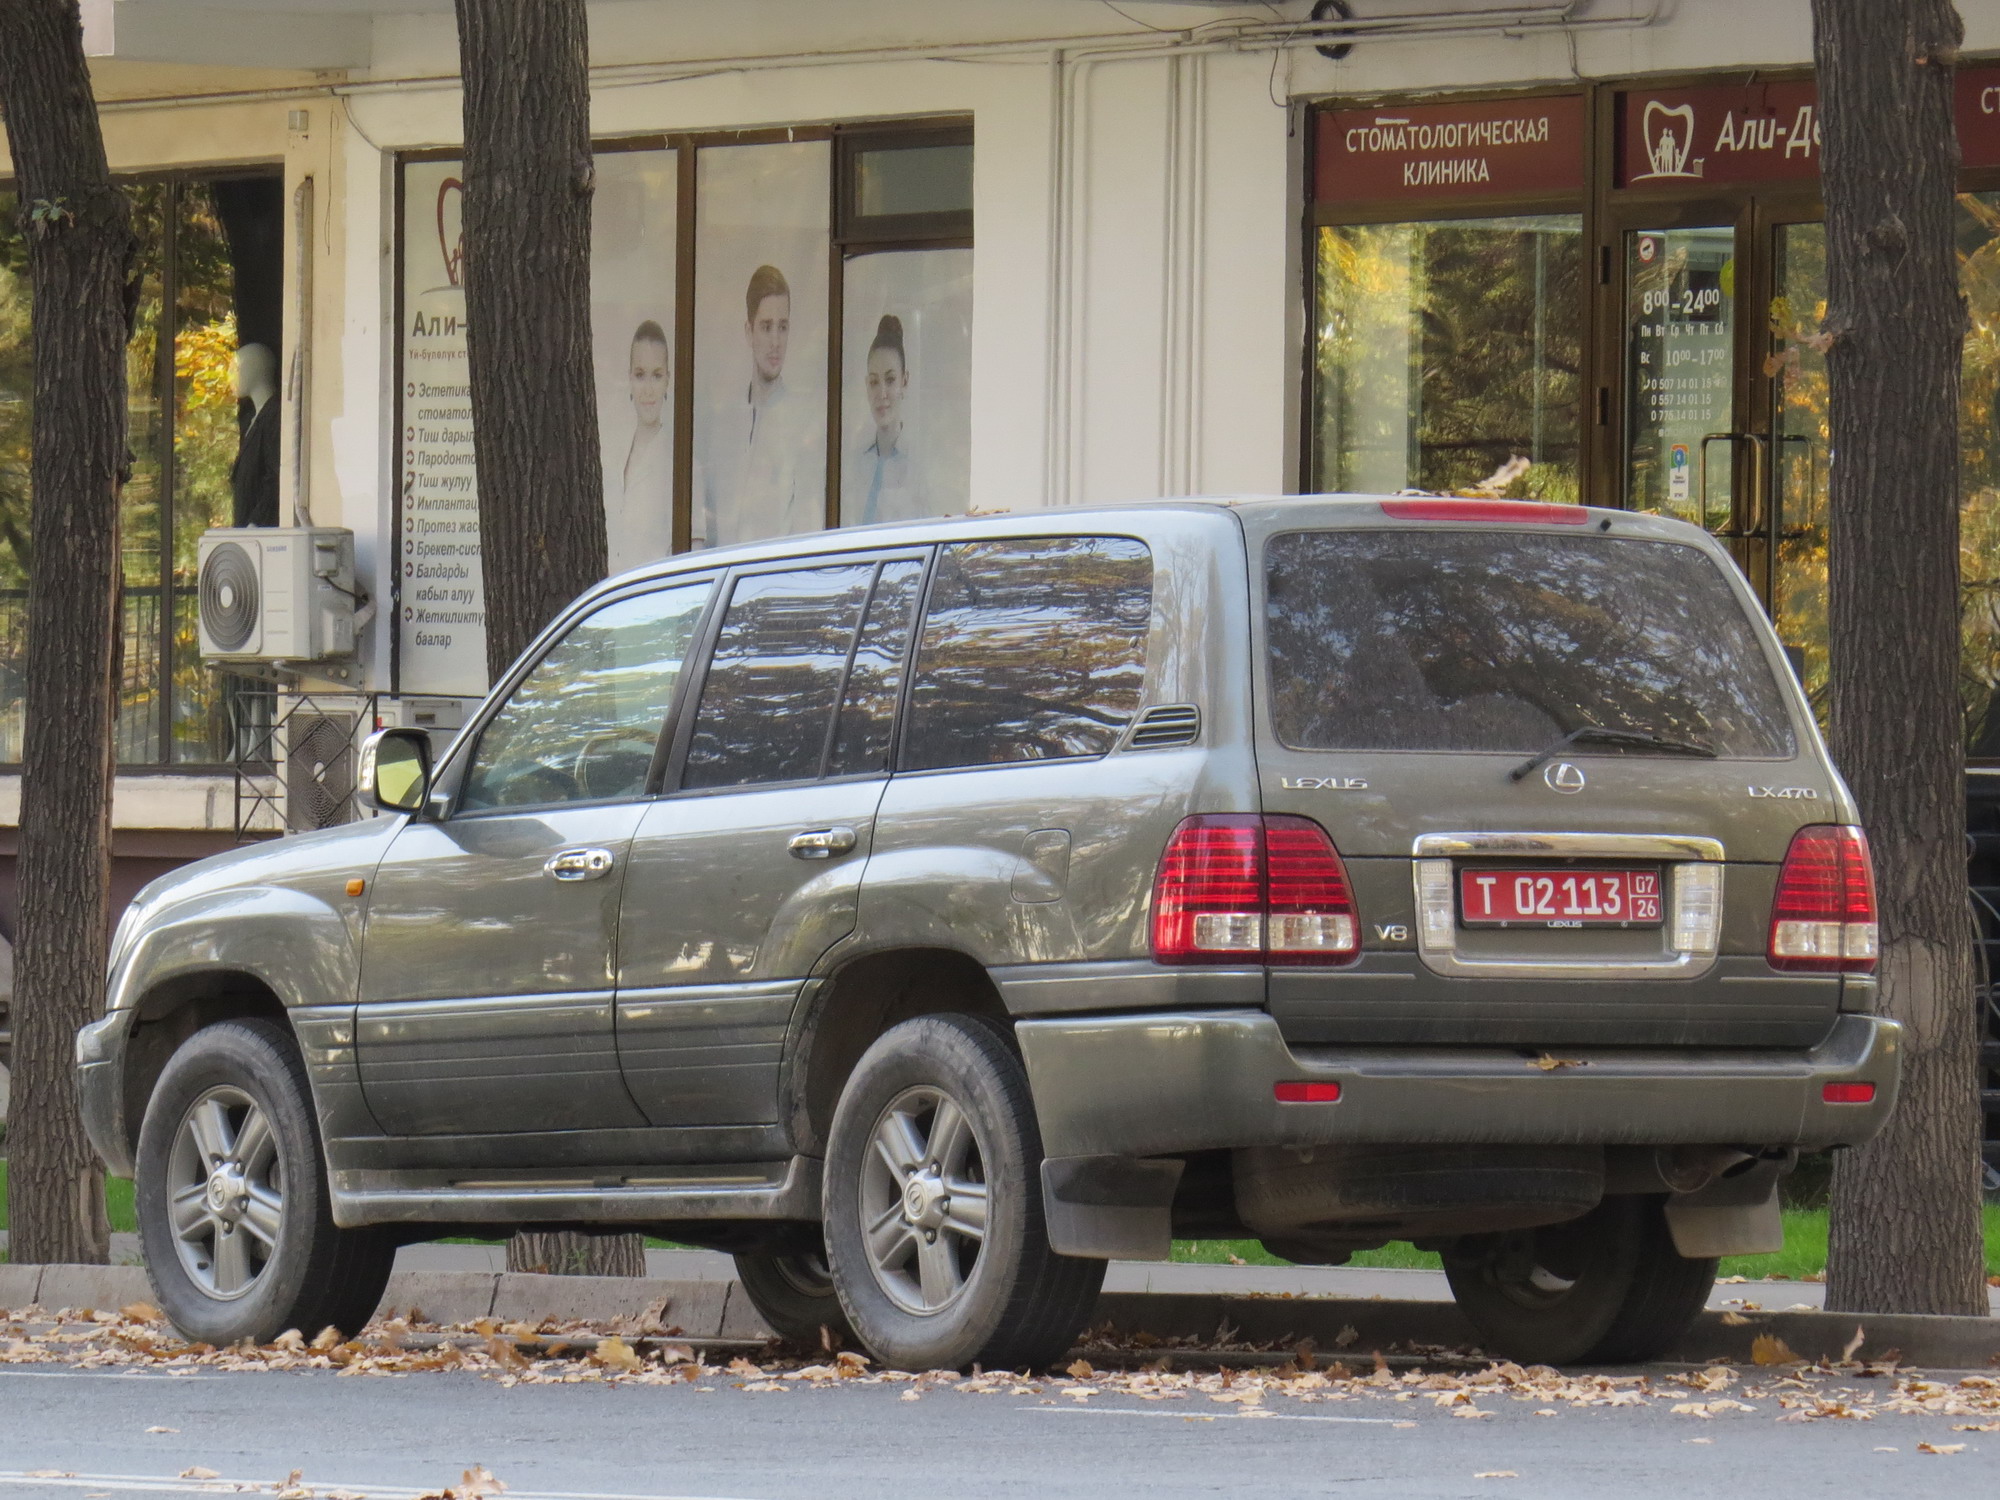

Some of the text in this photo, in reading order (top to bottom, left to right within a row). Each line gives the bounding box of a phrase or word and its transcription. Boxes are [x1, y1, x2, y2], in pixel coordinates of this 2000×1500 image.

[1346, 117, 1548, 153] СТОМАТОЛОГИЧЕСКАЯ
[1404, 158, 1489, 186] КЛИНИКА
[1641, 321, 1724, 338] Пн Вт Ср Чт Пт Сб
[1640, 351, 1650, 364] Вс
[1651, 378, 1657, 390] 0
[1651, 394, 1657, 406] 0
[1650, 410, 1657, 421] 0
[418, 428, 440, 443] Тиш
[418, 473, 473, 492] Тиш жулуу
[417, 496, 479, 513] Имплантац
[416, 518, 457, 536] Протез
[416, 563, 469, 582] Балдарды
[415, 585, 475, 605] кабыл алуу
[415, 630, 452, 650] баалар
[1281, 777, 1368, 790] LEXUS
[1635, 876, 1654, 893] 07
[1476, 877, 1497, 915] T
[1637, 899, 1656, 917] 26
[1374, 924, 1408, 941] V8
[1547, 920, 1583, 928] LEXUS
